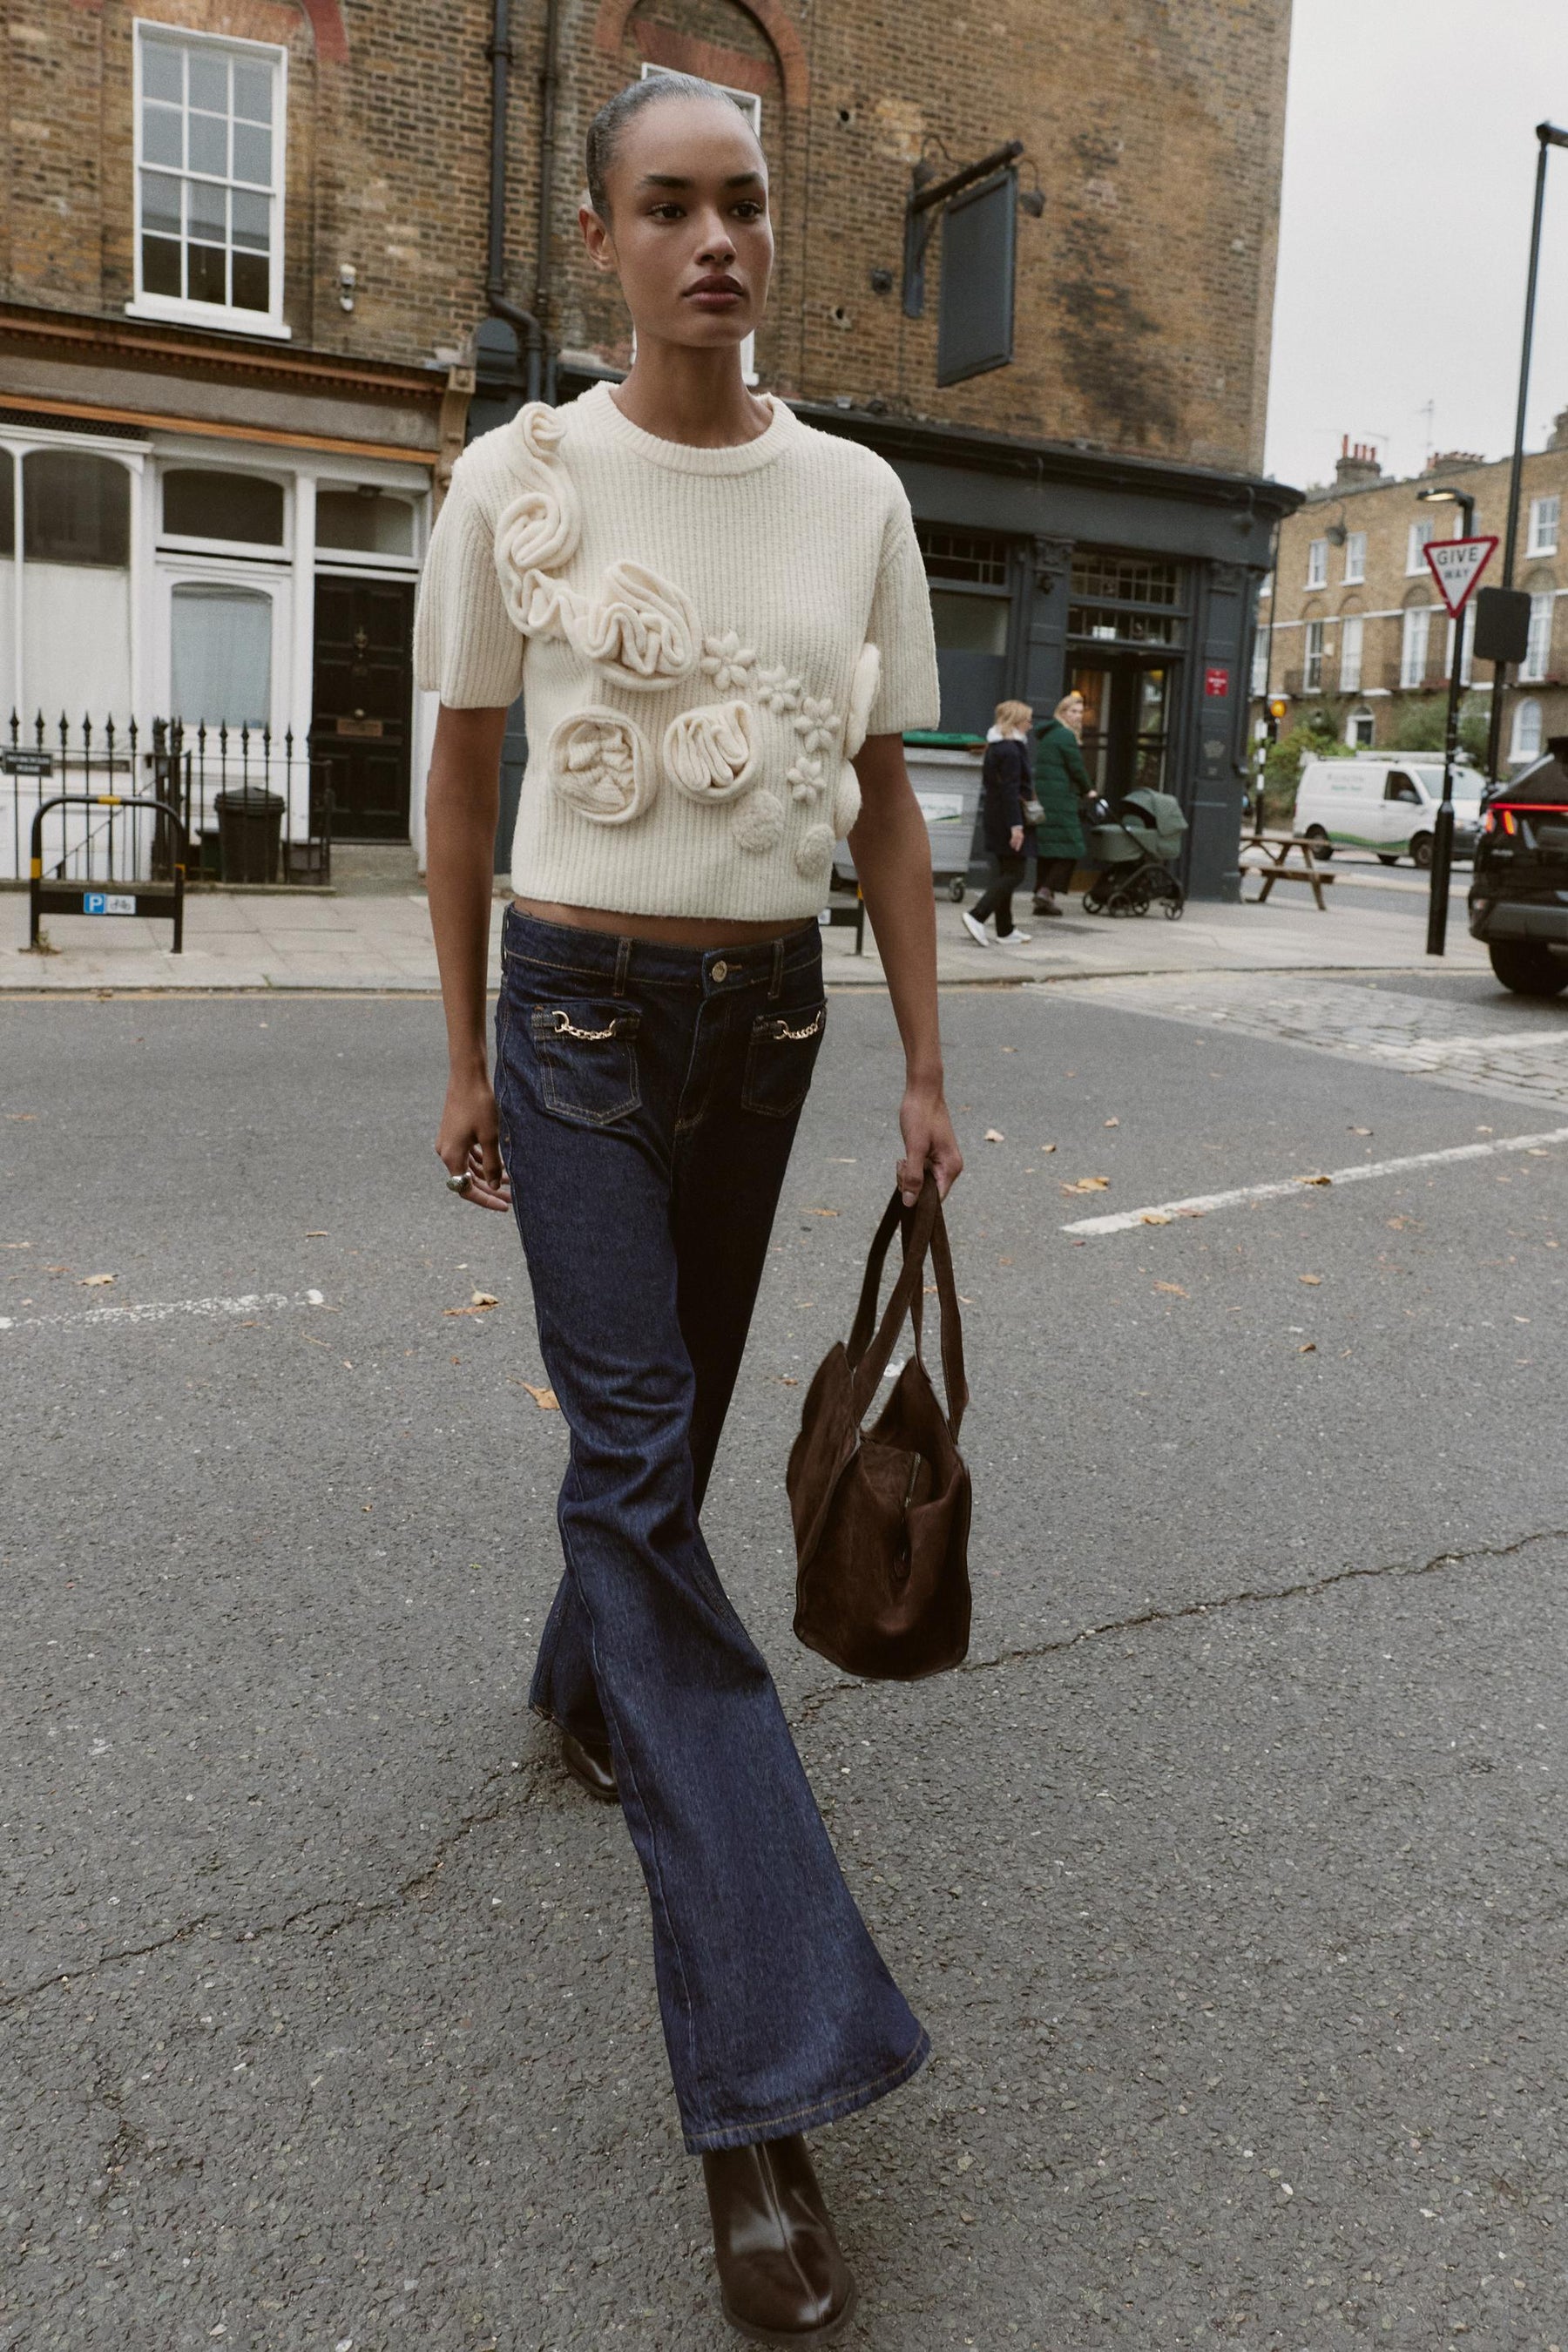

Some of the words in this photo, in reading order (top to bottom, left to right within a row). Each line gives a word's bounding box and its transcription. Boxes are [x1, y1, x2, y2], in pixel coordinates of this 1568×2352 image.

[1437, 547, 1478, 565] GIVE
[1444, 569, 1469, 579] WAY
[89, 895, 104, 912] P
